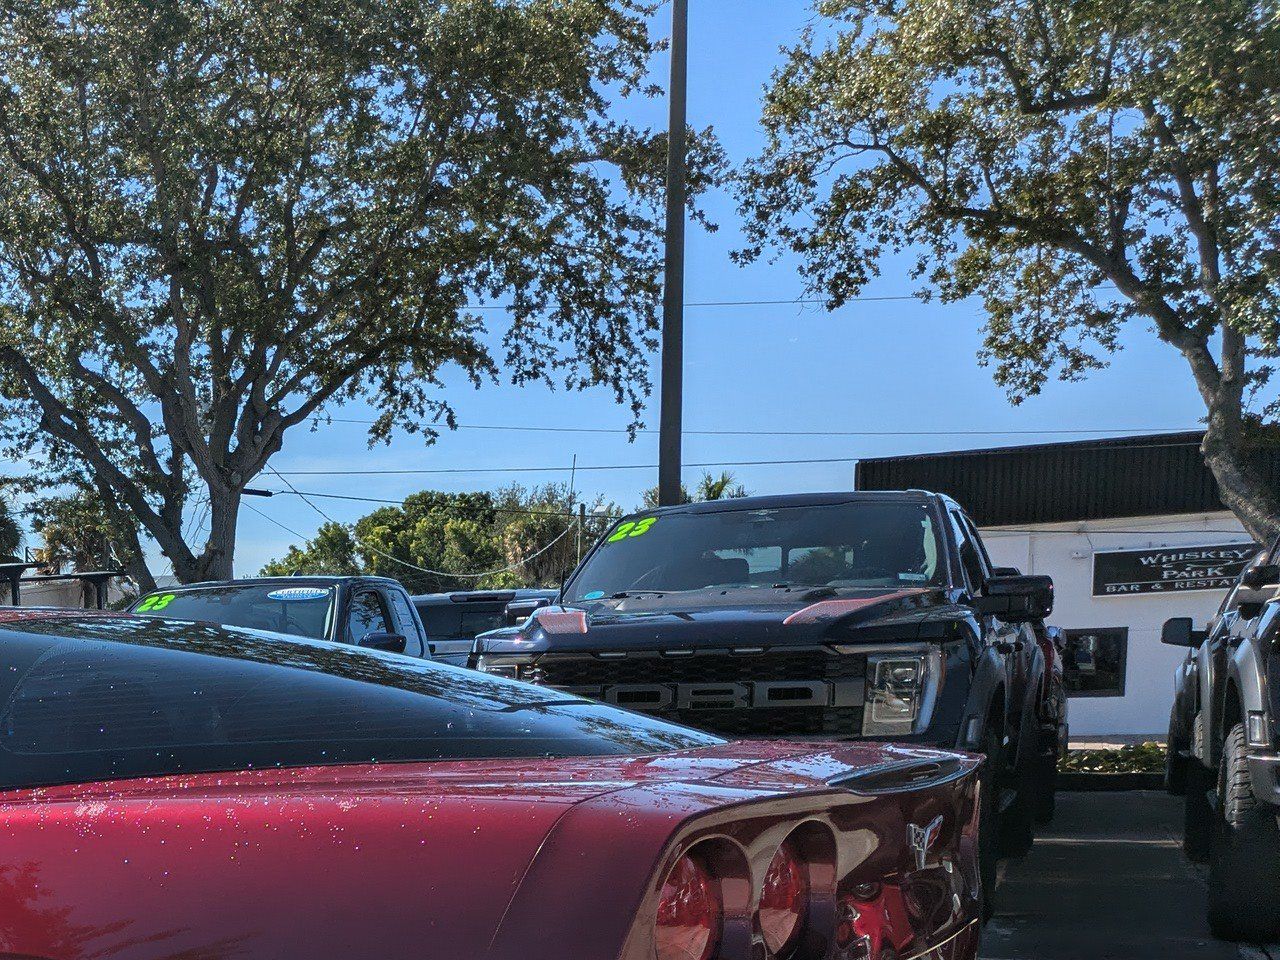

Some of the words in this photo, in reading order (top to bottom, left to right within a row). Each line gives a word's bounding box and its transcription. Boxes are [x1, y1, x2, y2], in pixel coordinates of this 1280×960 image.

[607, 517, 658, 542] 23
[1140, 549, 1253, 565] WHISKEY
[1162, 567, 1223, 579] PARK
[1106, 584, 1140, 593] BAR
[1151, 582, 1163, 590] &
[1175, 577, 1238, 589] RESTA
[136, 594, 176, 613] 23
